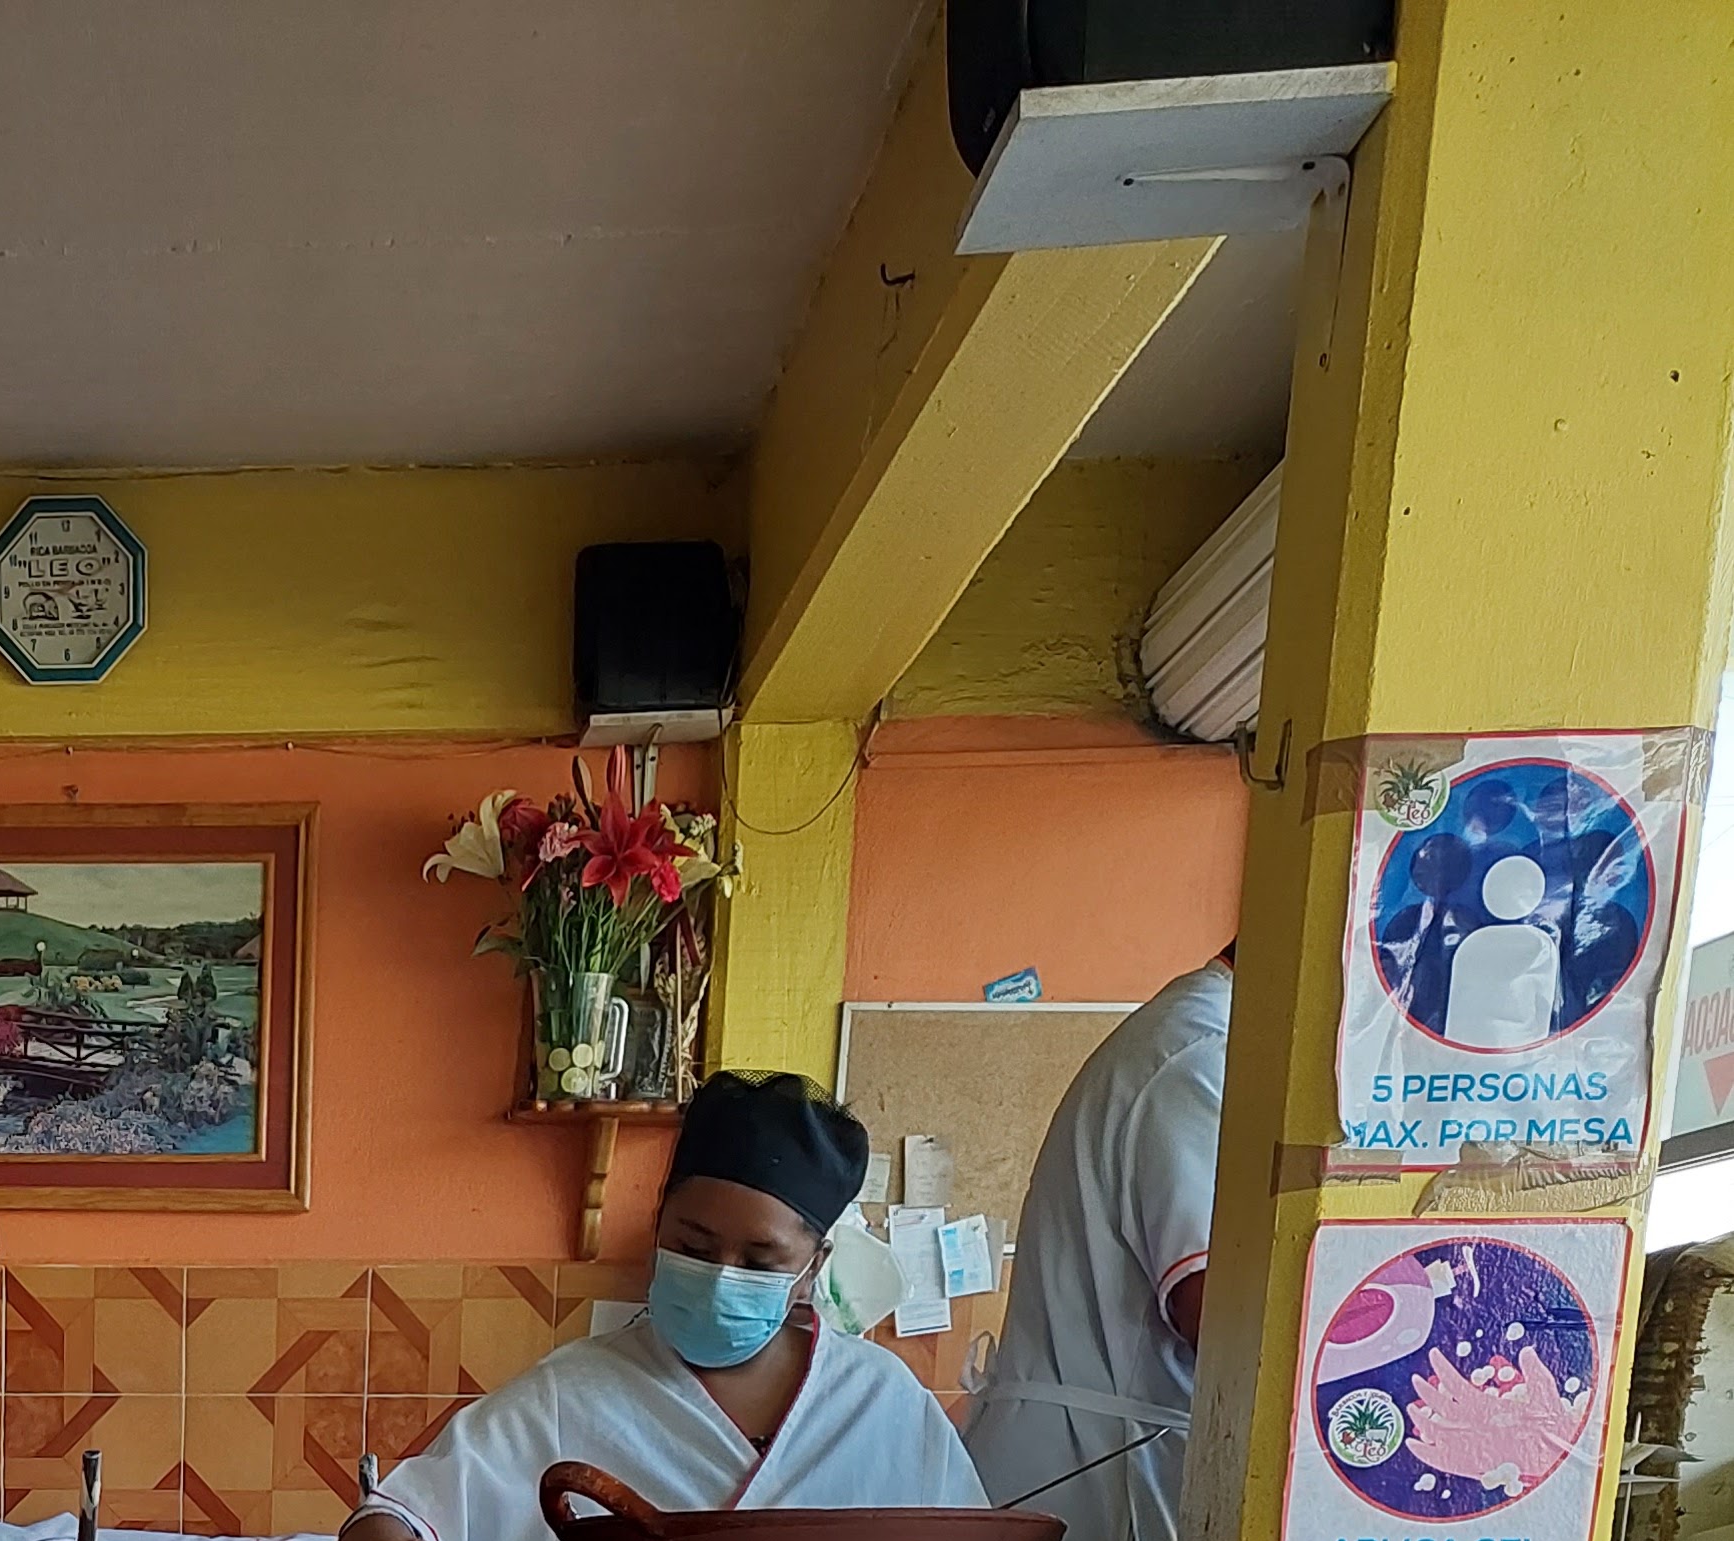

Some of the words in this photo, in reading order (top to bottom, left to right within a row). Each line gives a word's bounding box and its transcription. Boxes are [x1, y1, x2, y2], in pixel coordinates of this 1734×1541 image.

[30, 545, 50, 556] RICA
[1372, 1076, 1394, 1103] 5
[1402, 1071, 1609, 1103] PERSONAS
[1439, 1119, 1518, 1148] POR
[1527, 1117, 1634, 1147] MESA
